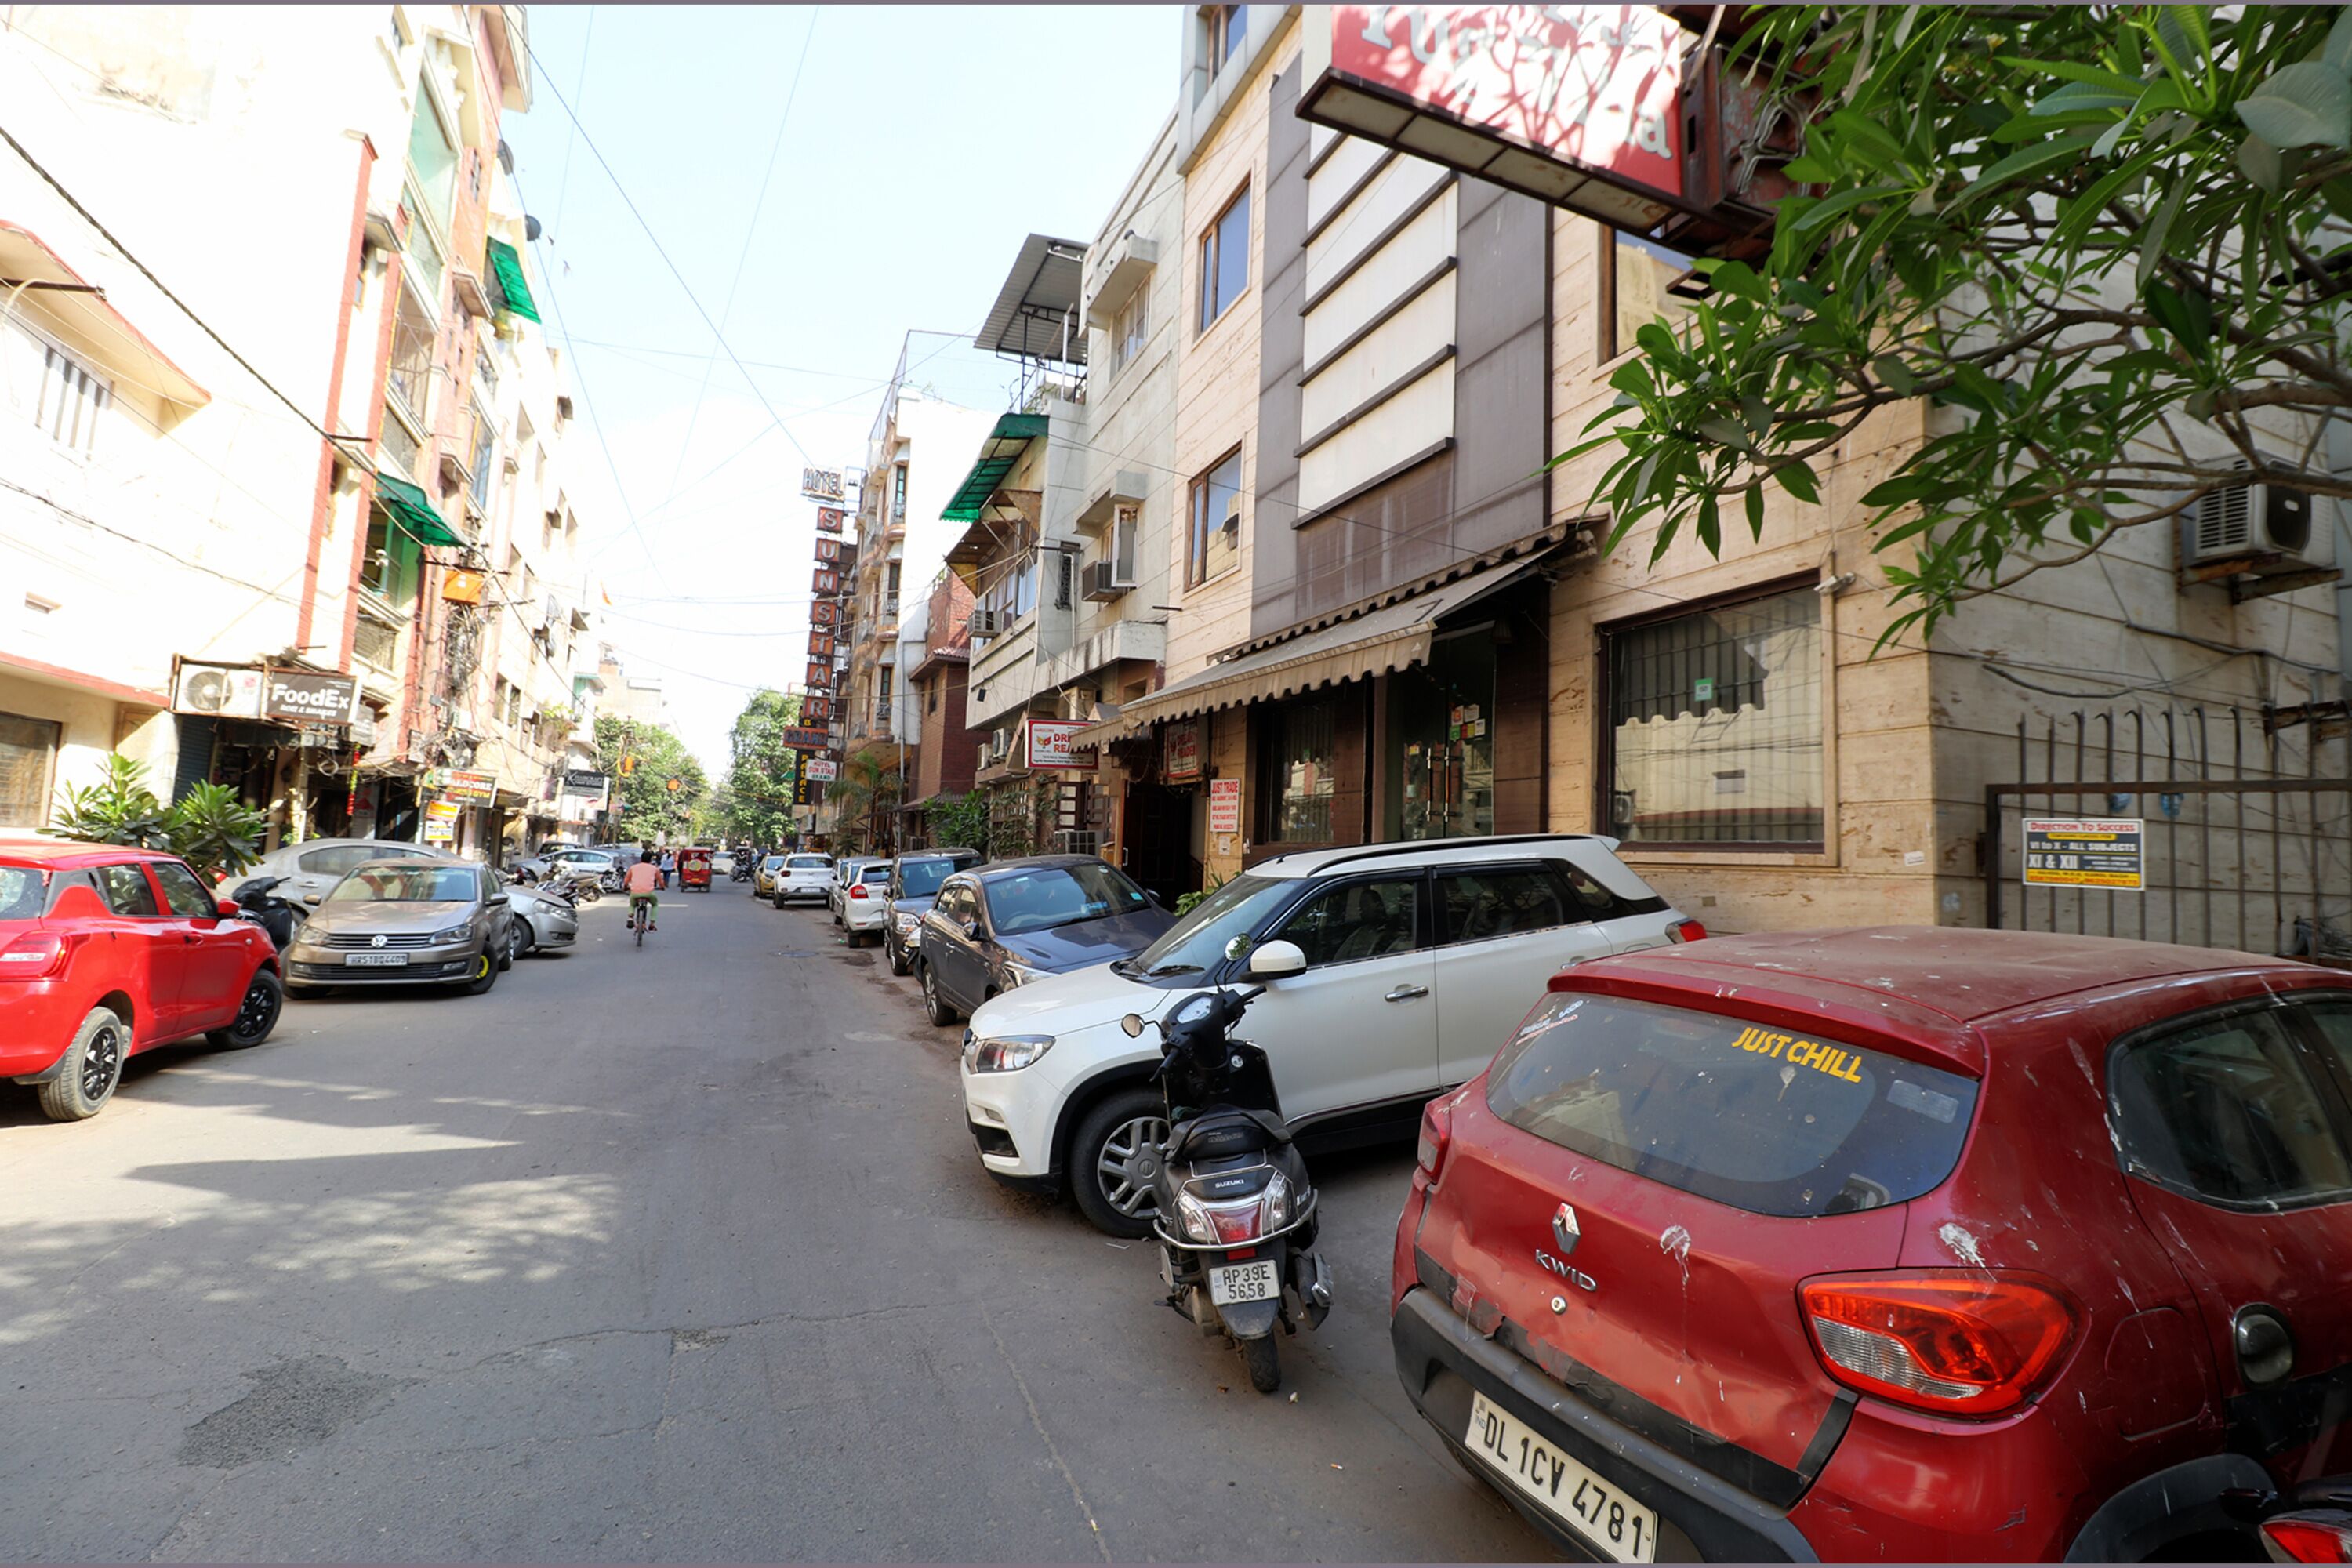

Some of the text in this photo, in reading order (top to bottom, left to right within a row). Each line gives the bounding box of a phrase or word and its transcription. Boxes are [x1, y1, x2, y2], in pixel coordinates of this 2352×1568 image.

[803, 468, 844, 495] HOTEL
[271, 683, 350, 709] FoodEx
[798, 755, 808, 803] PALACE
[1212, 782, 1238, 793] JUST TRADE
[2031, 822, 2078, 831] DIRECTION
[2088, 843, 2136, 851] SUBJECTS
[2027, 854, 2078, 869] XI & XII
[1731, 1027, 1863, 1083] JUST CHILL
[1215, 1178, 1244, 1189] SUZUKI
[1536, 1248, 1596, 1291] KWID
[1229, 1282, 1265, 1300] 5658
[1484, 1411, 1508, 1463] DL
[1572, 1479, 1643, 1559] 4781
